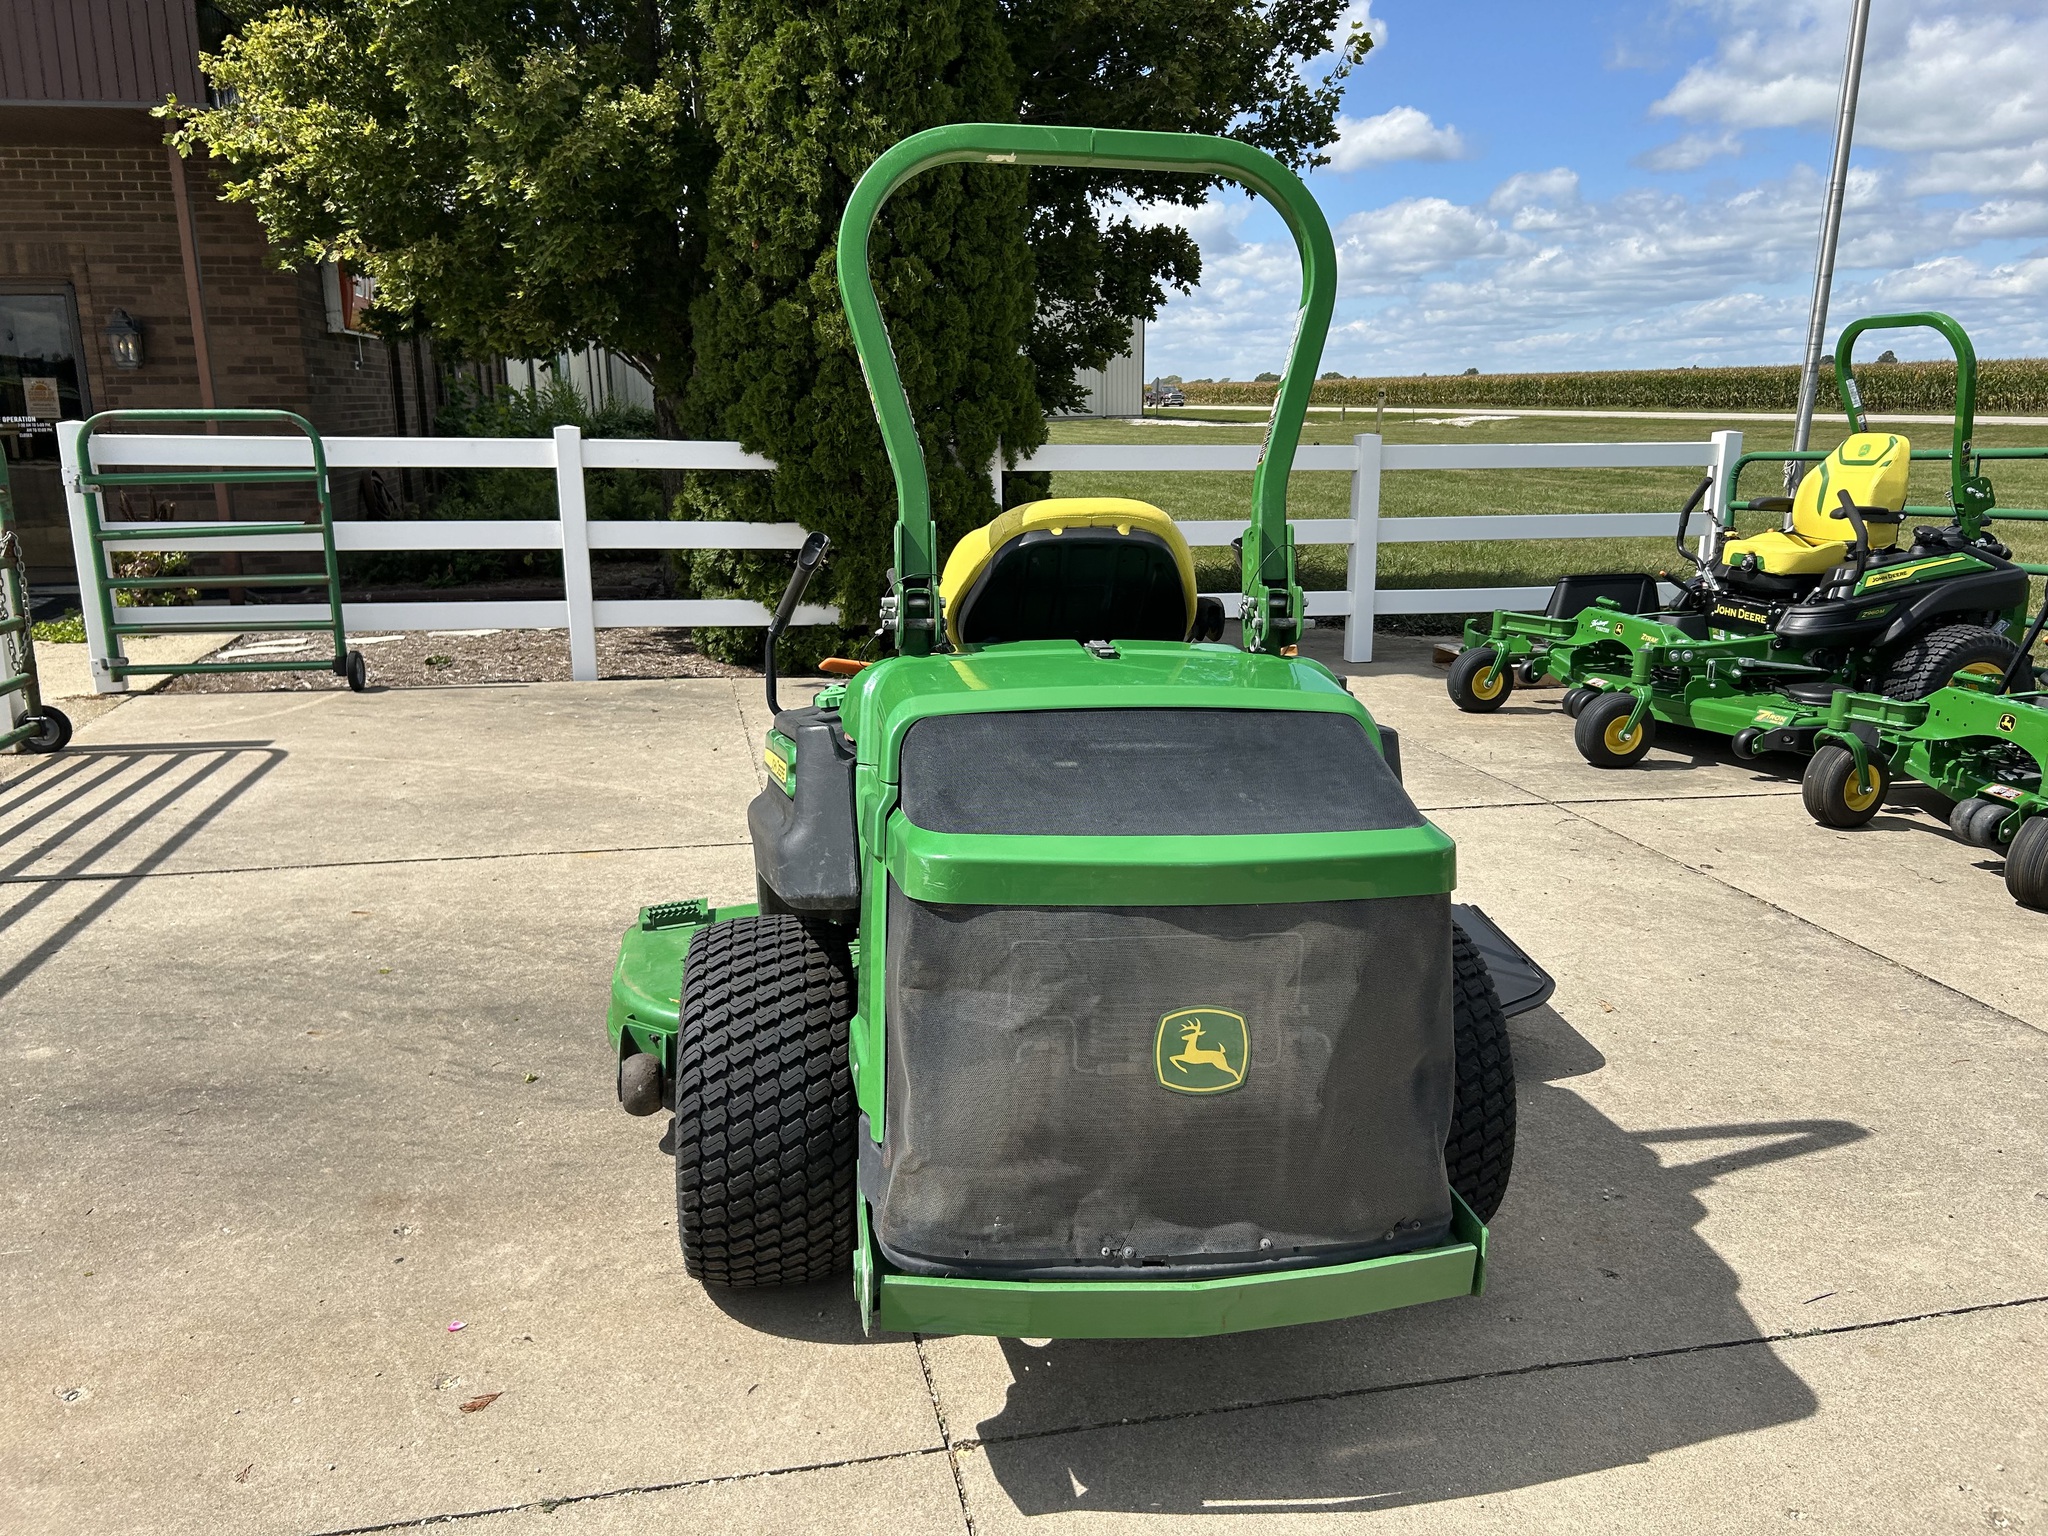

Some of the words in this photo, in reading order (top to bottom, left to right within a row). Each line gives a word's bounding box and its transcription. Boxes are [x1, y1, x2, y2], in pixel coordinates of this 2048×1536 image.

[1872, 575, 1888, 583] JOHN
[1888, 570, 1908, 579] DEERE
[1714, 604, 1737, 618] JOHN
[1738, 609, 1767, 624] DEERE
